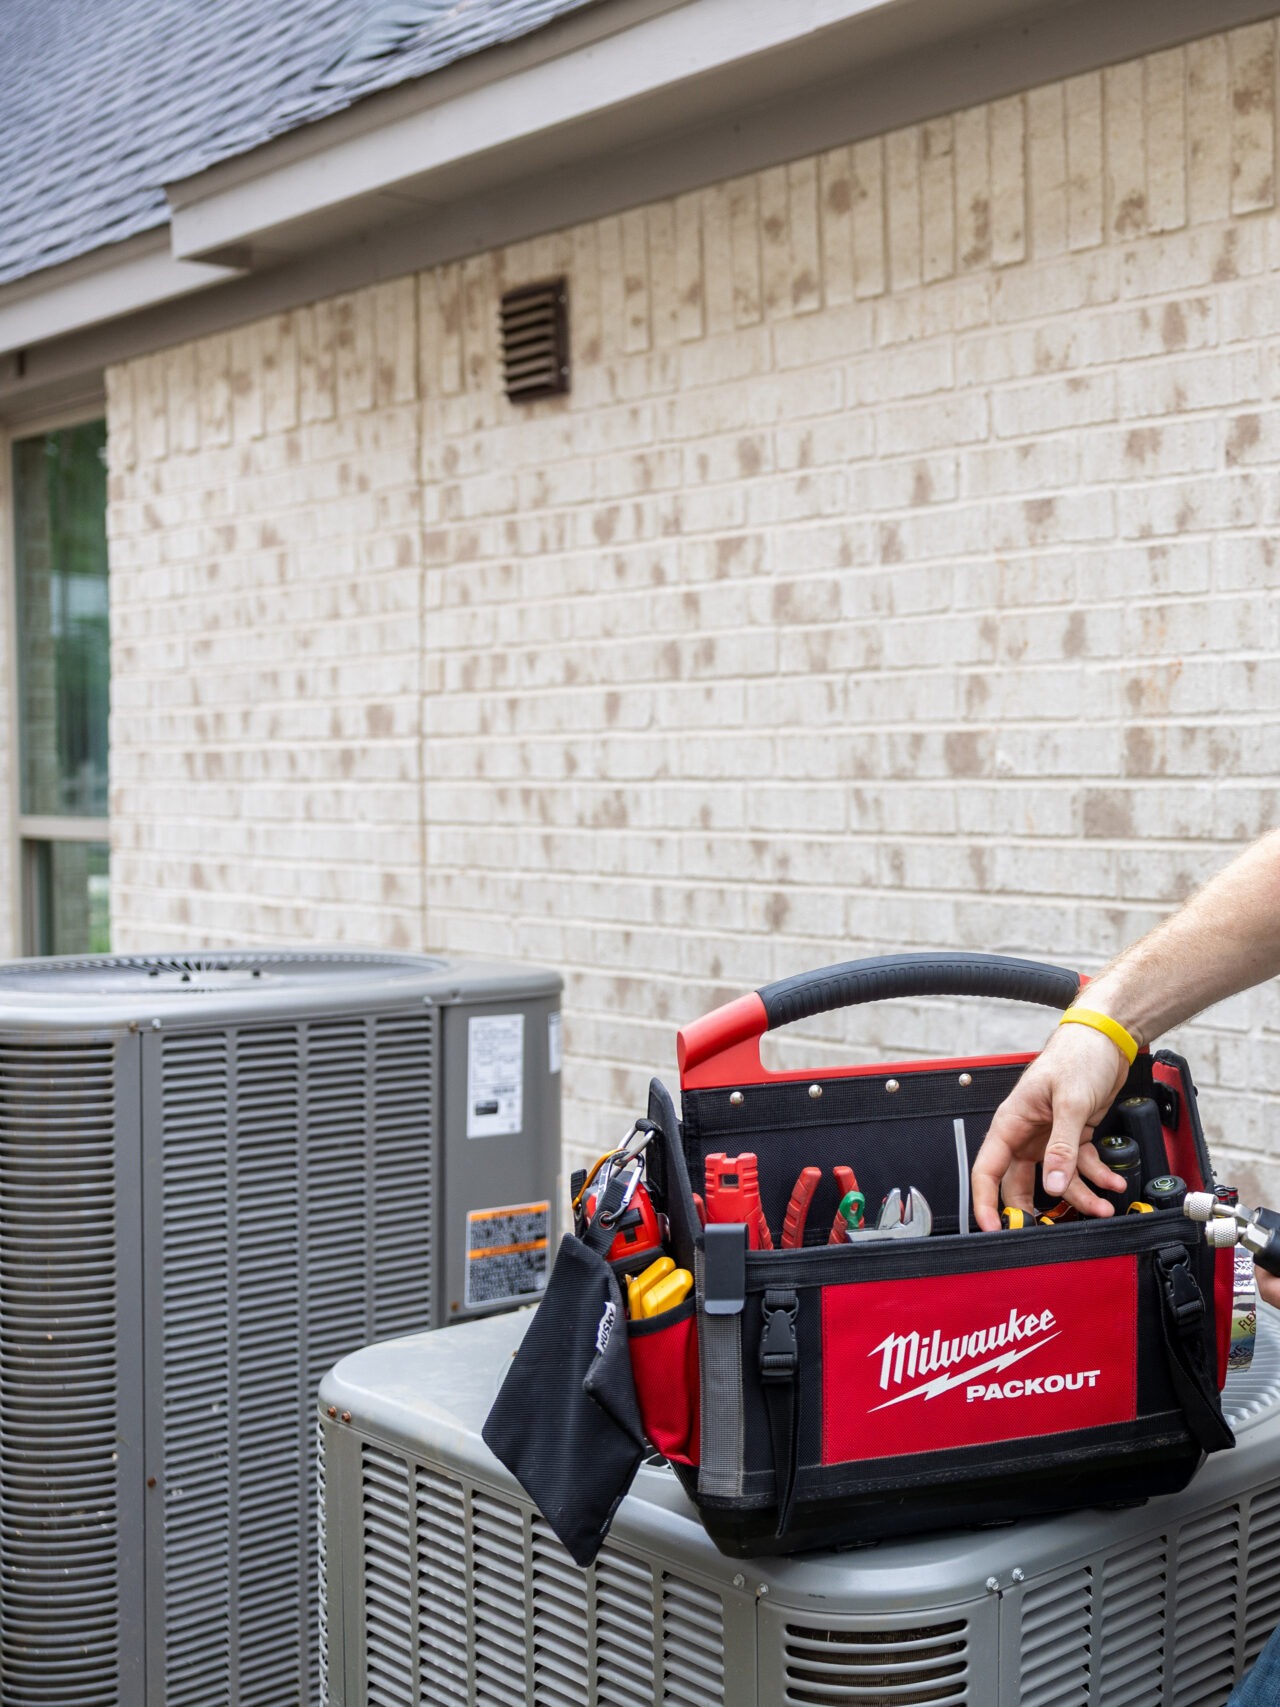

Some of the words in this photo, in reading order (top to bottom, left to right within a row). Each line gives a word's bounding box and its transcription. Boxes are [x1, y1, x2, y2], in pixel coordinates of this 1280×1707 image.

[600, 1307, 615, 1351] HUSKY
[866, 1308, 1057, 1391] Milwaukee
[966, 1369, 1101, 1403] PACKOUT
